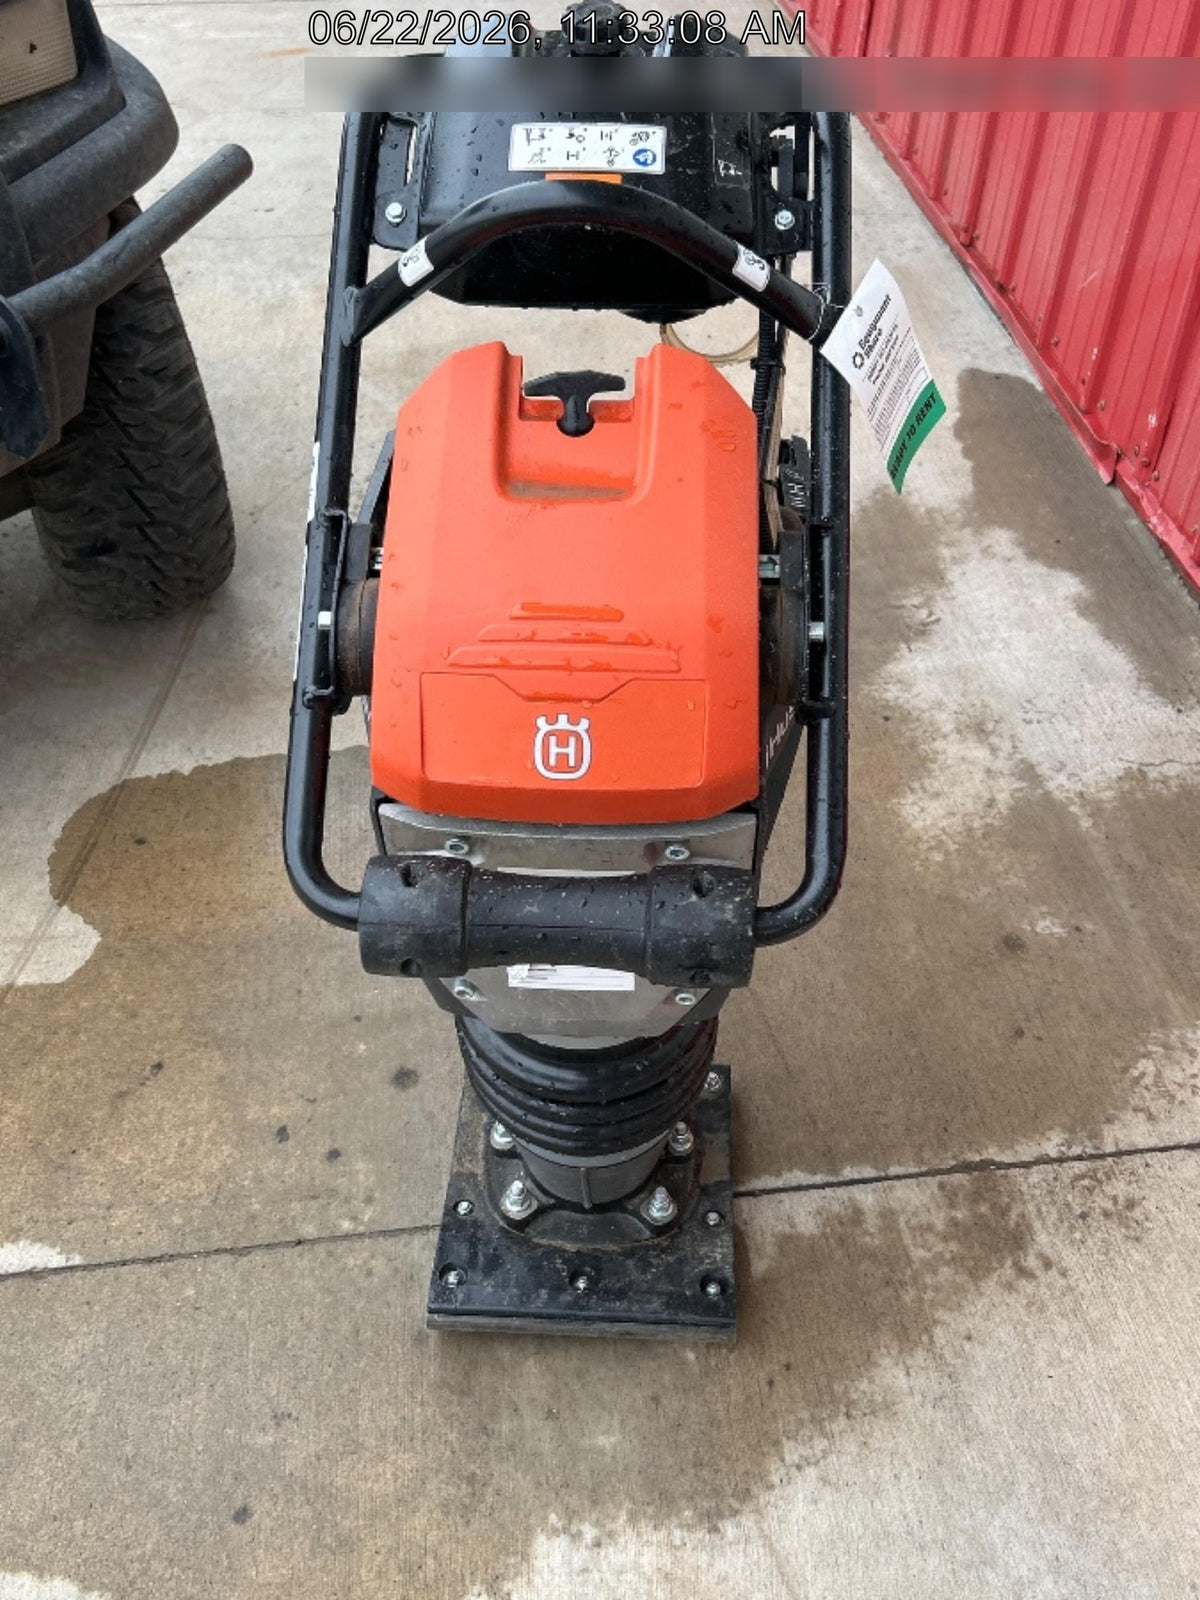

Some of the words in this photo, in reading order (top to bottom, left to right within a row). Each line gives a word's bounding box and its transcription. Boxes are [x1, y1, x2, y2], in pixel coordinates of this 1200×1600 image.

[889, 441, 908, 480] READY
[906, 424, 918, 439] TO
[916, 391, 937, 427] RENT
